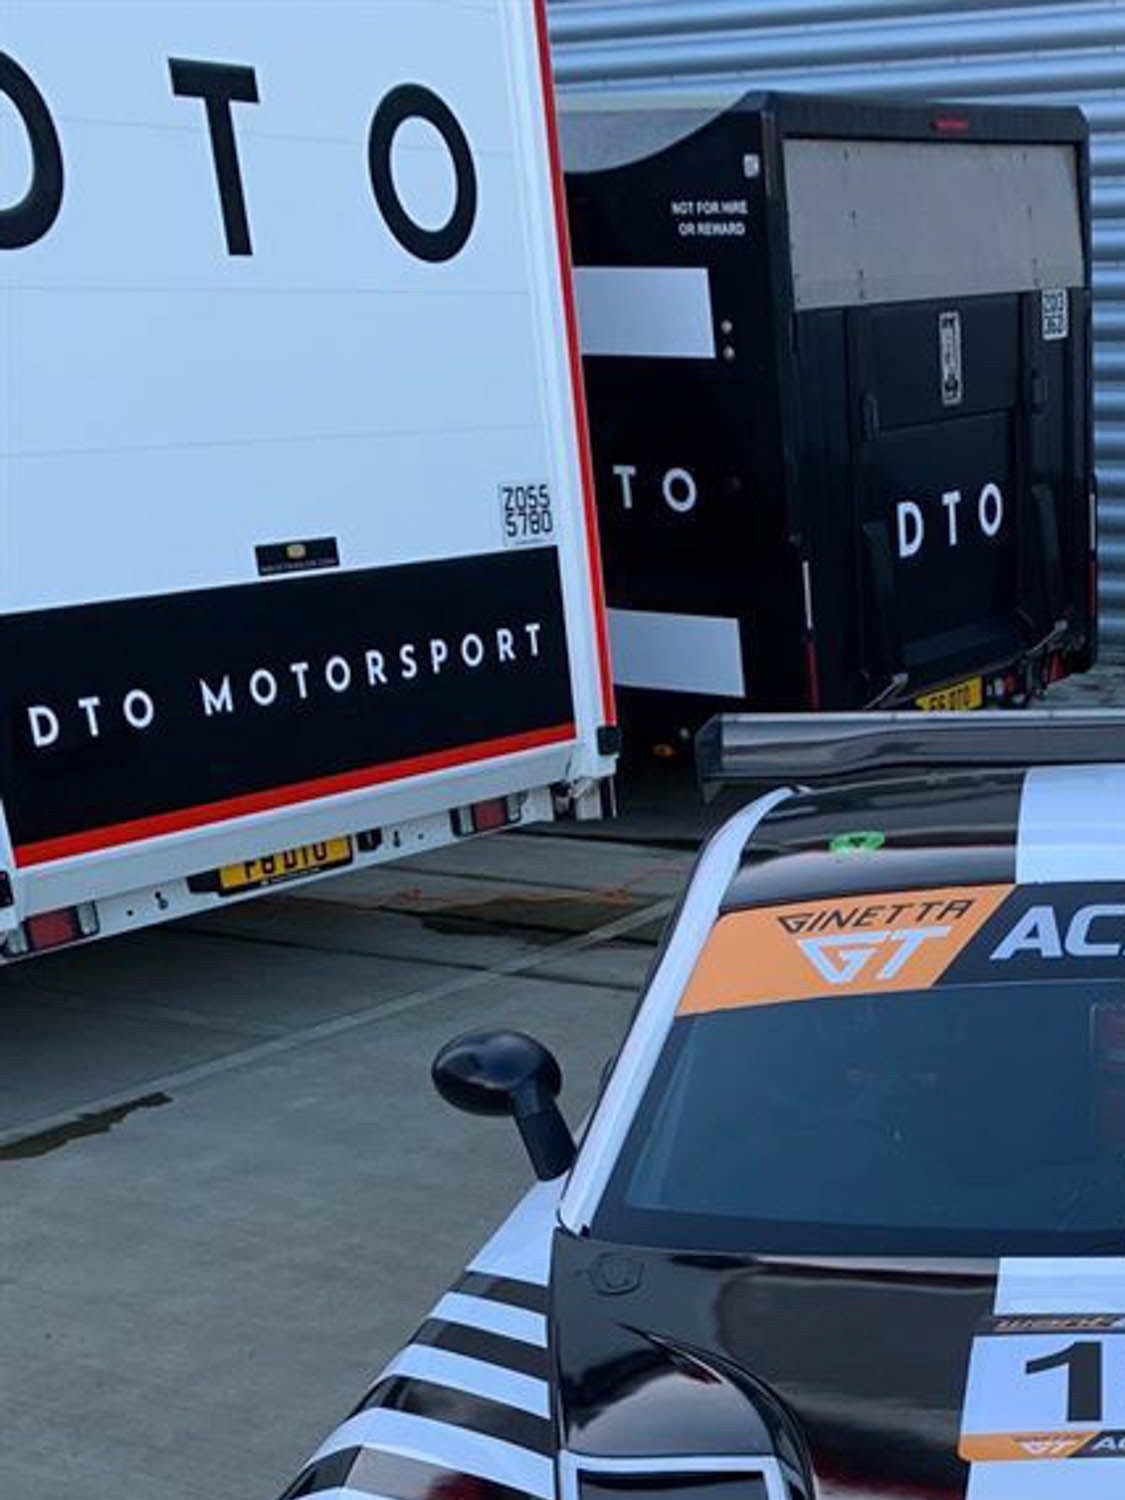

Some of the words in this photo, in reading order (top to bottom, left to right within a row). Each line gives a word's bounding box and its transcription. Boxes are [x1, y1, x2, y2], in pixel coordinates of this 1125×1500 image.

[613, 465, 697, 512] TO
[505, 509, 553, 538] 5780
[898, 483, 1002, 558] DTO
[28, 689, 154, 747] DTO
[200, 624, 541, 715] MOTORSPORT
[777, 899, 978, 934] GINETTA
[797, 925, 952, 985] GT
